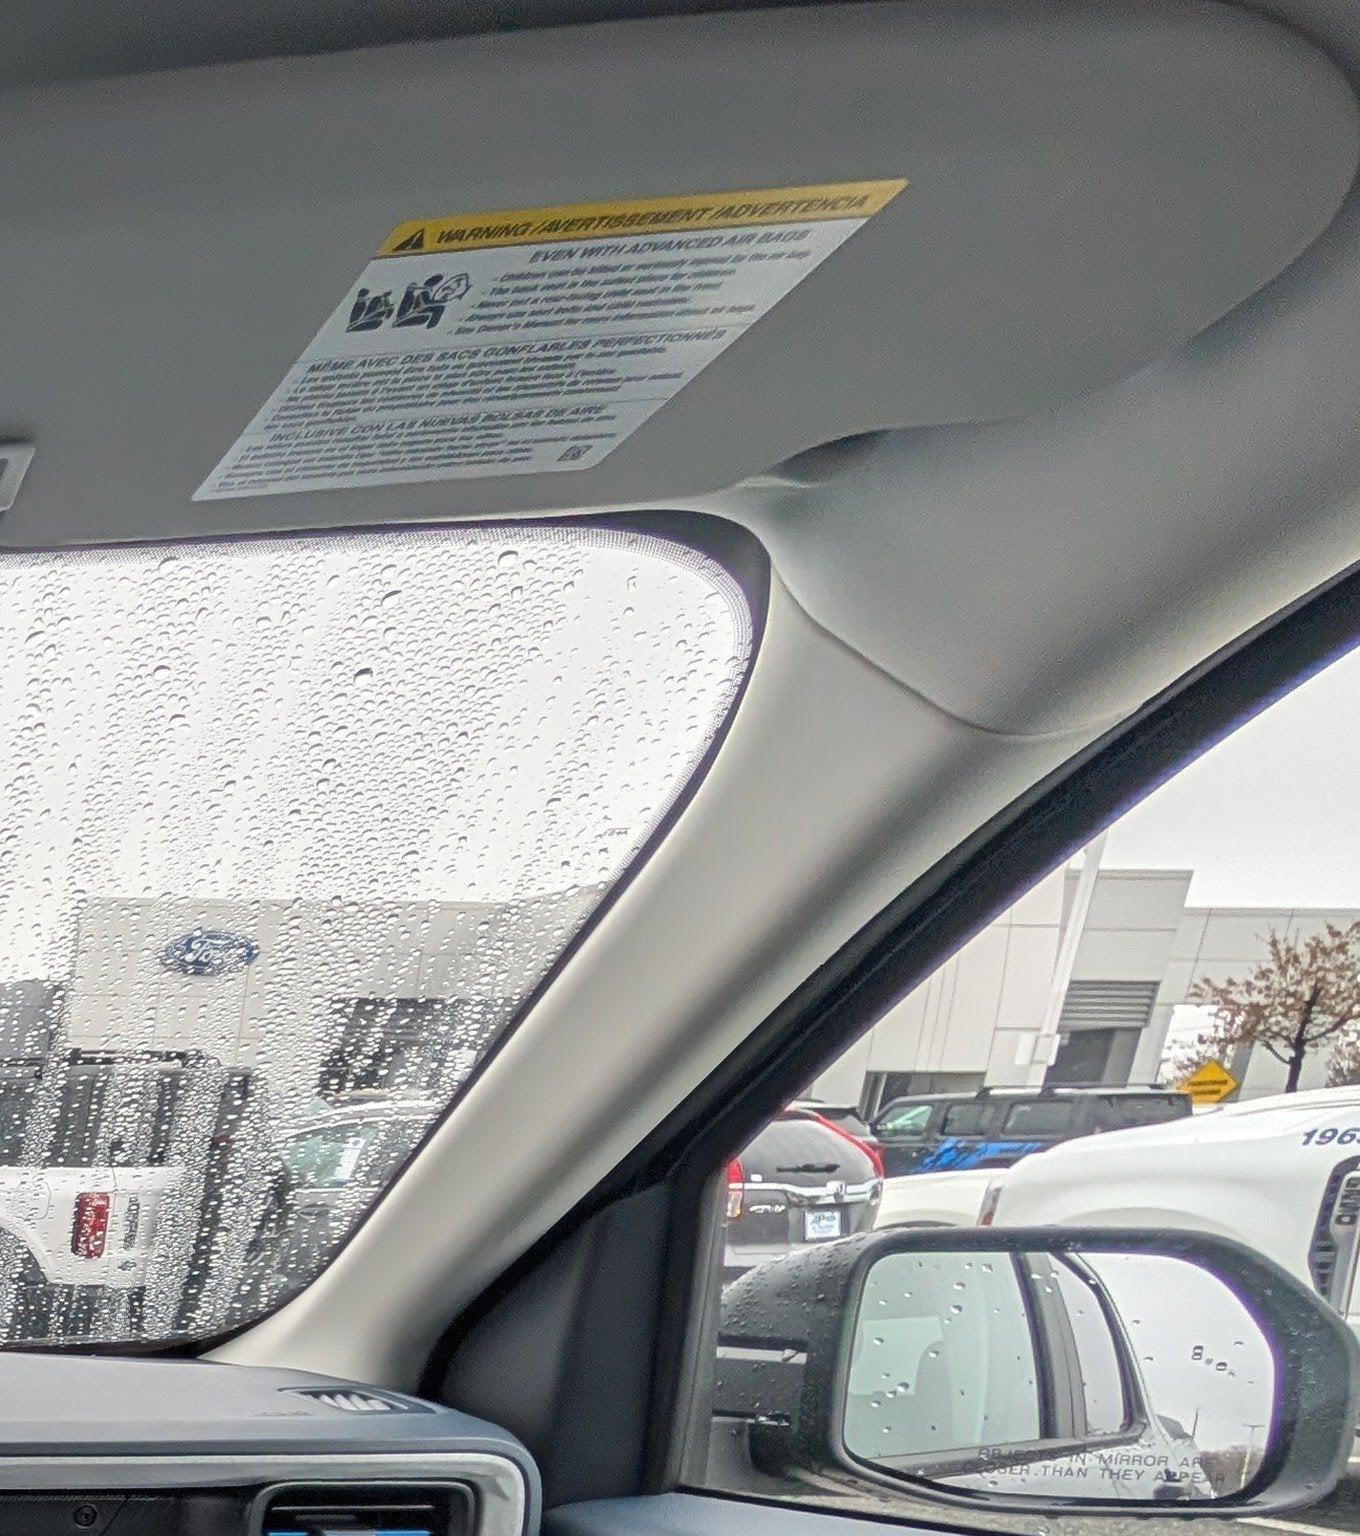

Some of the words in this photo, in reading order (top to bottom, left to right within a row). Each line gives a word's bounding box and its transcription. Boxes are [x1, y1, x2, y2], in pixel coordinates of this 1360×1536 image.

[432, 221, 535, 244] WARNING
[526, 248, 580, 263] EVEN
[576, 243, 629, 258] WITH
[720, 232, 760, 247] AIR
[1302, 1127, 1360, 1146] 196
[1099, 1453, 1169, 1467] MIRROR
[1043, 1465, 1088, 1479] THAN
[1100, 1468, 1144, 1481] THEY
